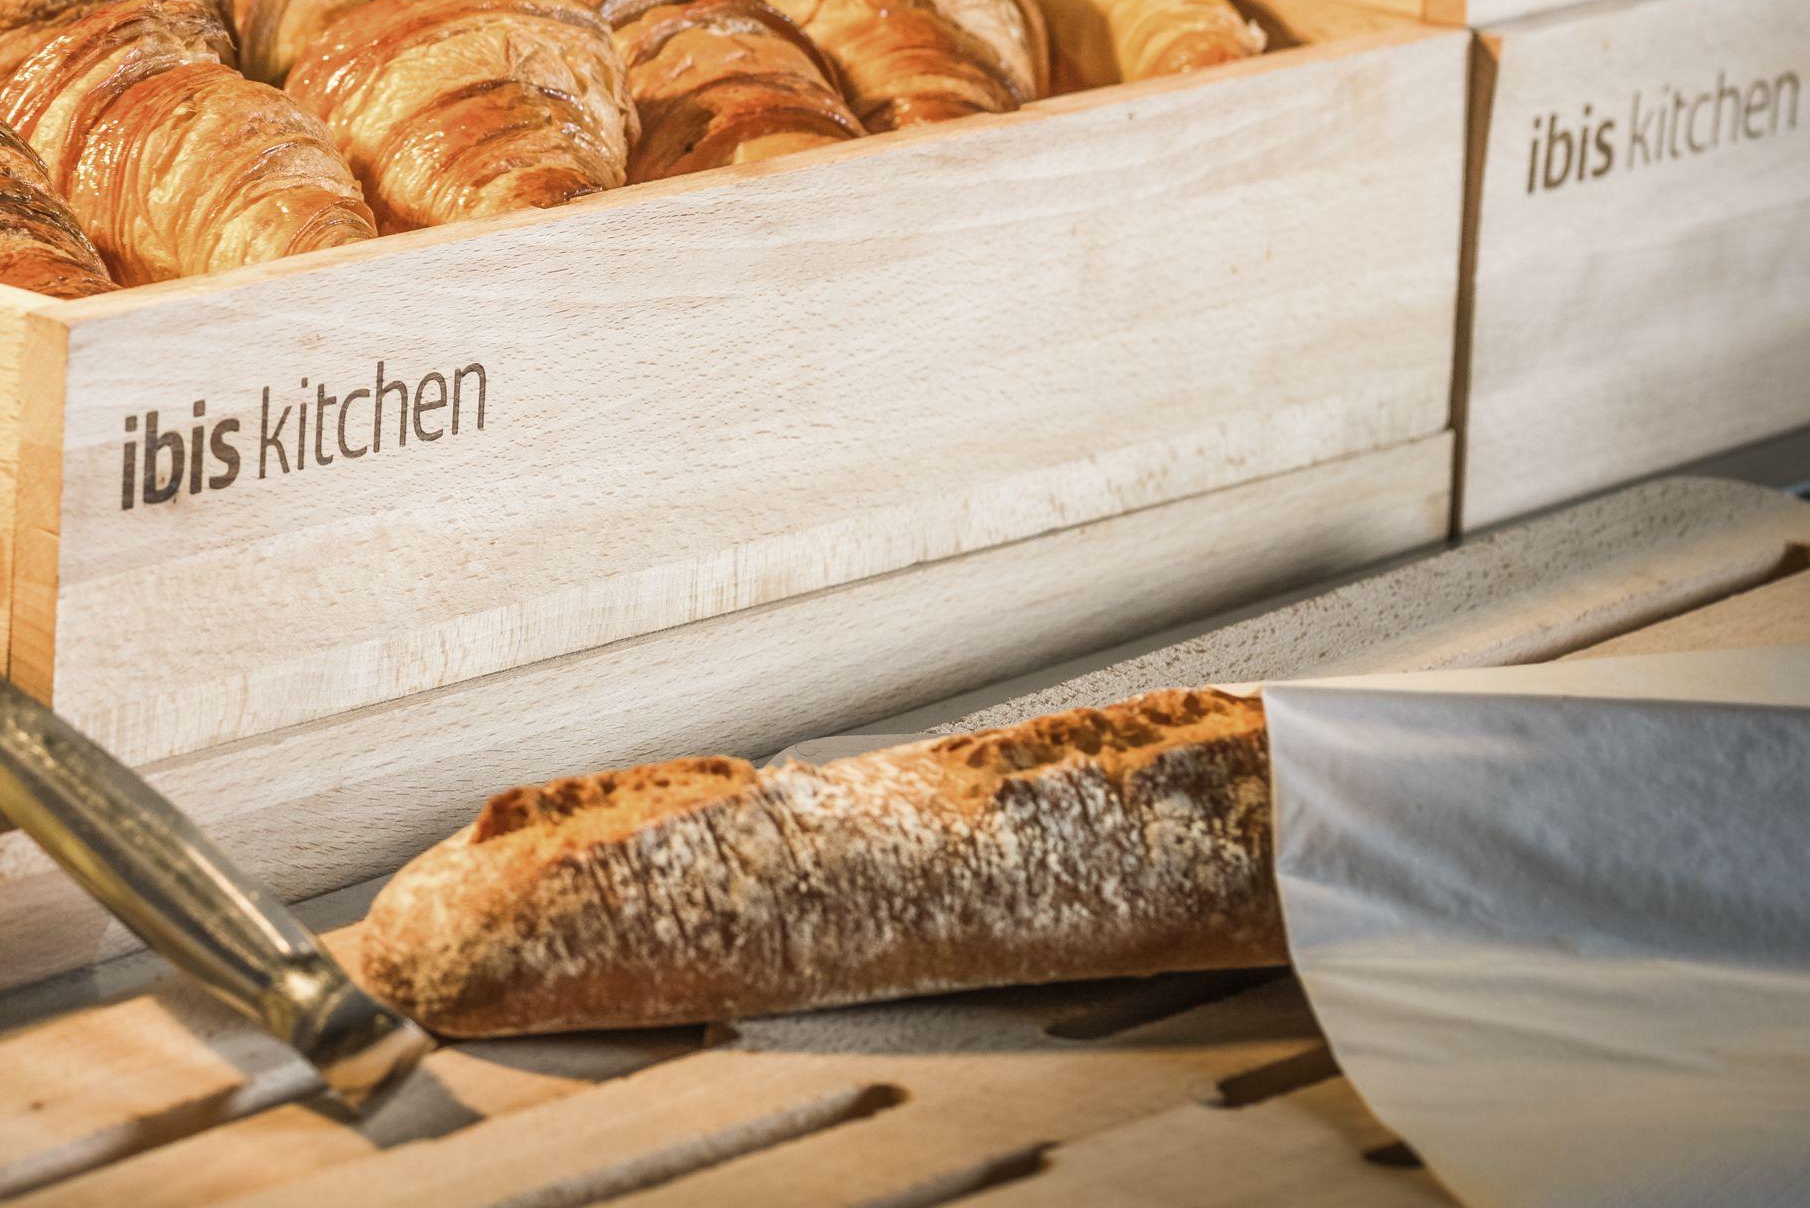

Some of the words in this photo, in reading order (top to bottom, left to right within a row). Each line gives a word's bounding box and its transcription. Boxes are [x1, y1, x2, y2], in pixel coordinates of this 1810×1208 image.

[1525, 102, 1617, 197] ibis
[1626, 68, 1801, 171] kitchen
[121, 399, 241, 511] ibis
[257, 360, 487, 480] kitchen
